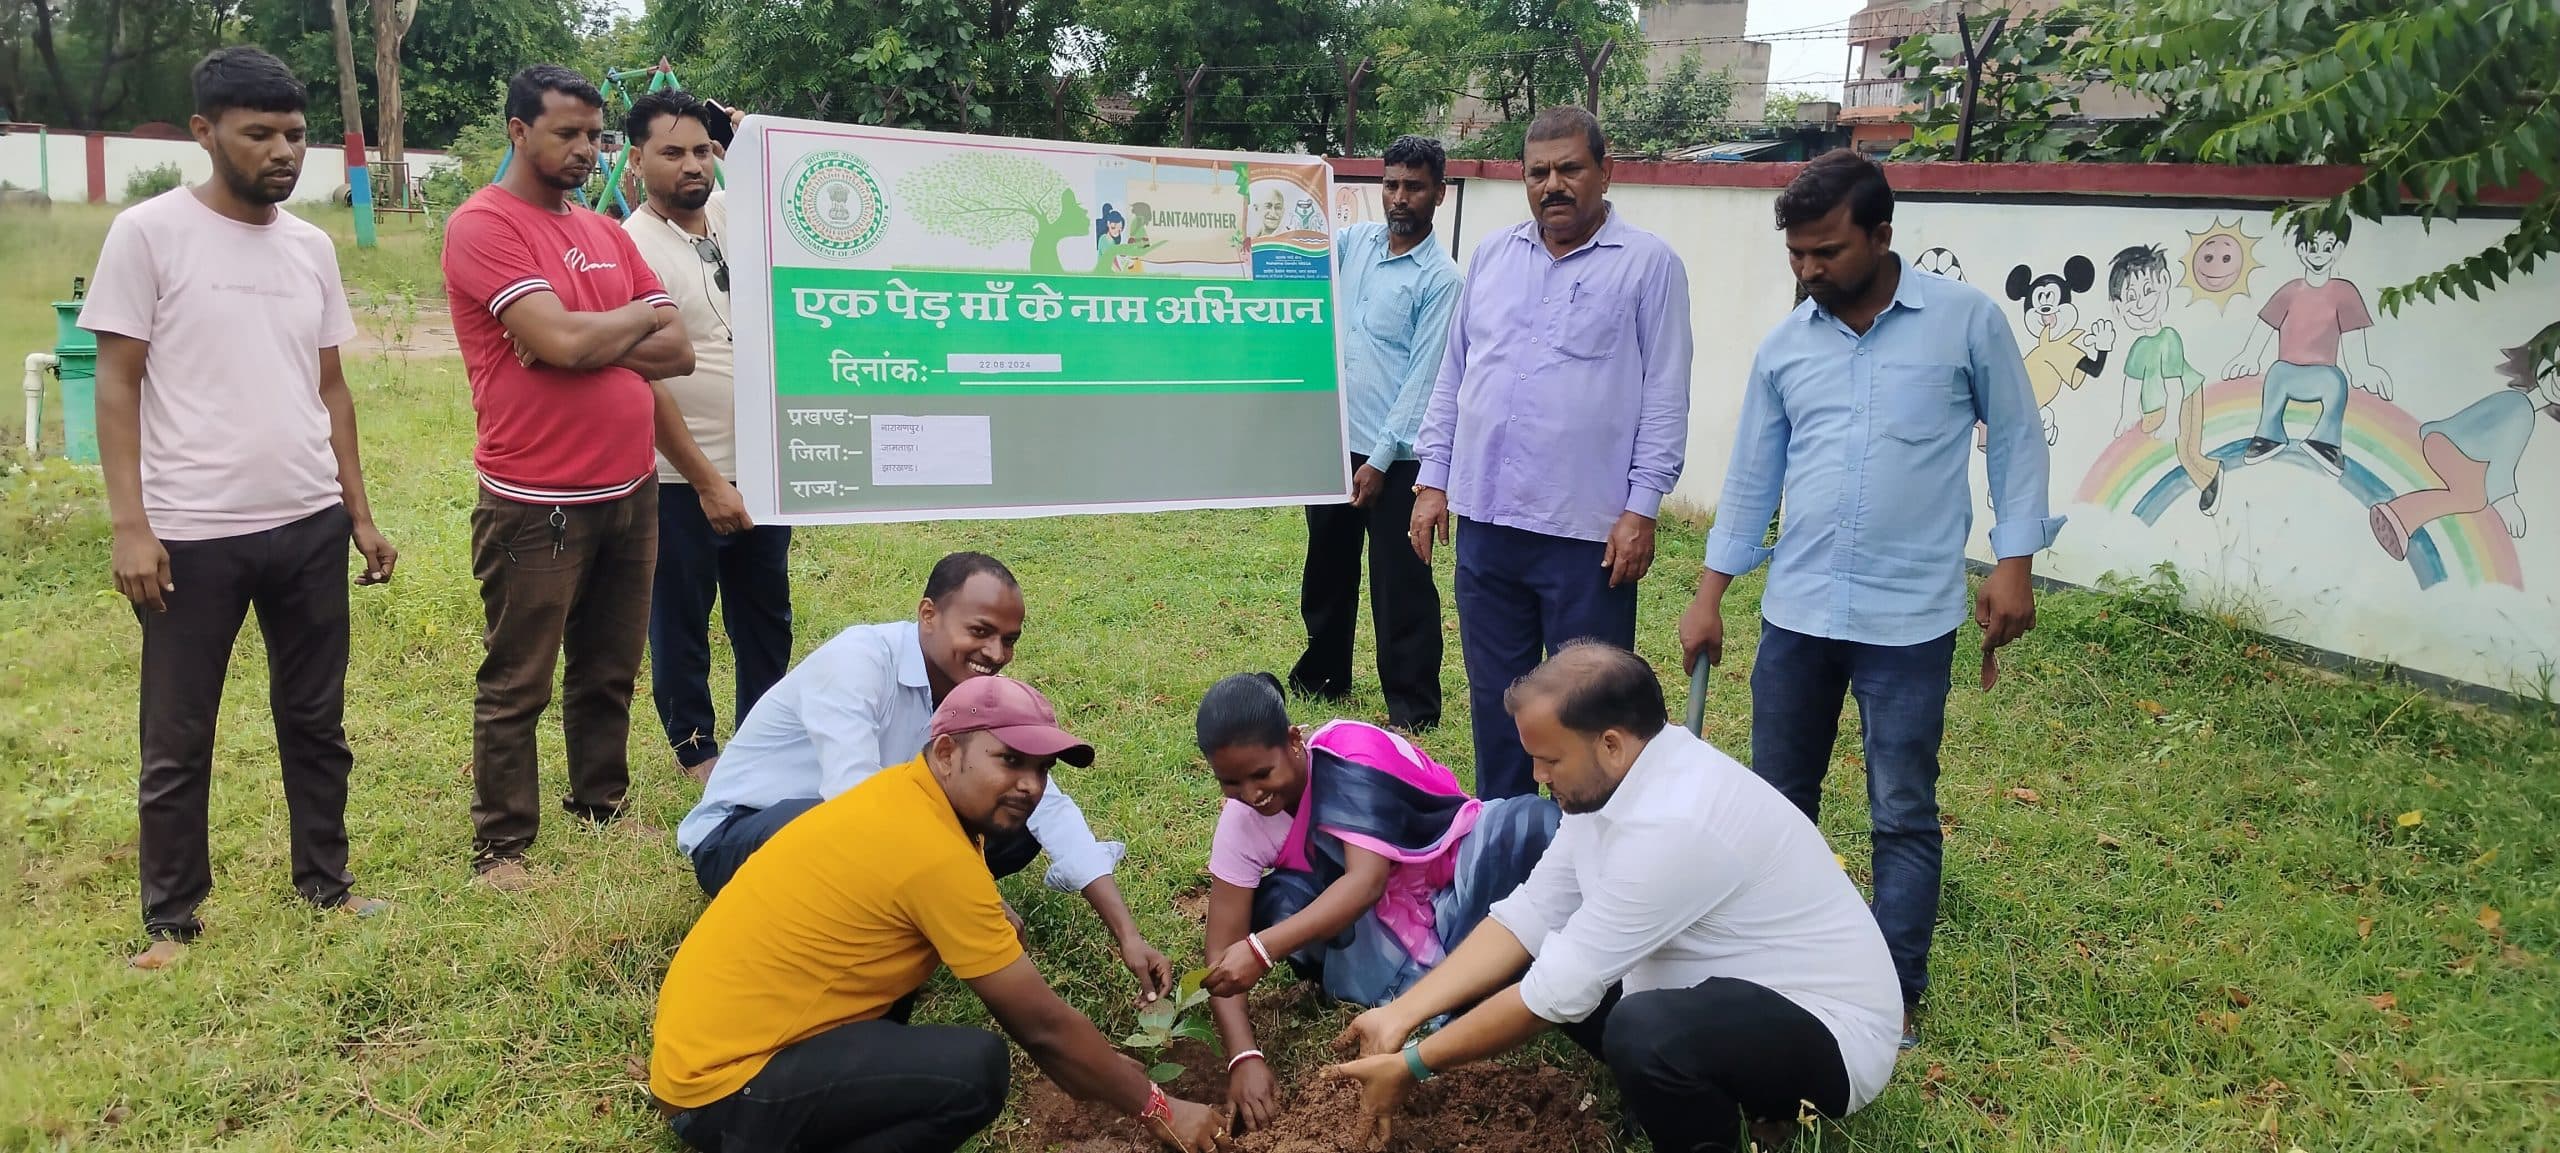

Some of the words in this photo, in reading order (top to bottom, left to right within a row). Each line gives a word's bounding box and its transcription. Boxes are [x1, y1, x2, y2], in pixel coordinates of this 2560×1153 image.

[787, 210, 835, 257] GOVERNMENT
[851, 215, 889, 256] JHARKHAND
[791, 287, 880, 329] एक
[885, 278, 952, 329] पेड़
[958, 281, 1015, 321] माँ
[1016, 282, 1064, 322] के
[1068, 295, 1149, 323] नाम
[1156, 286, 1324, 324] अभियान
